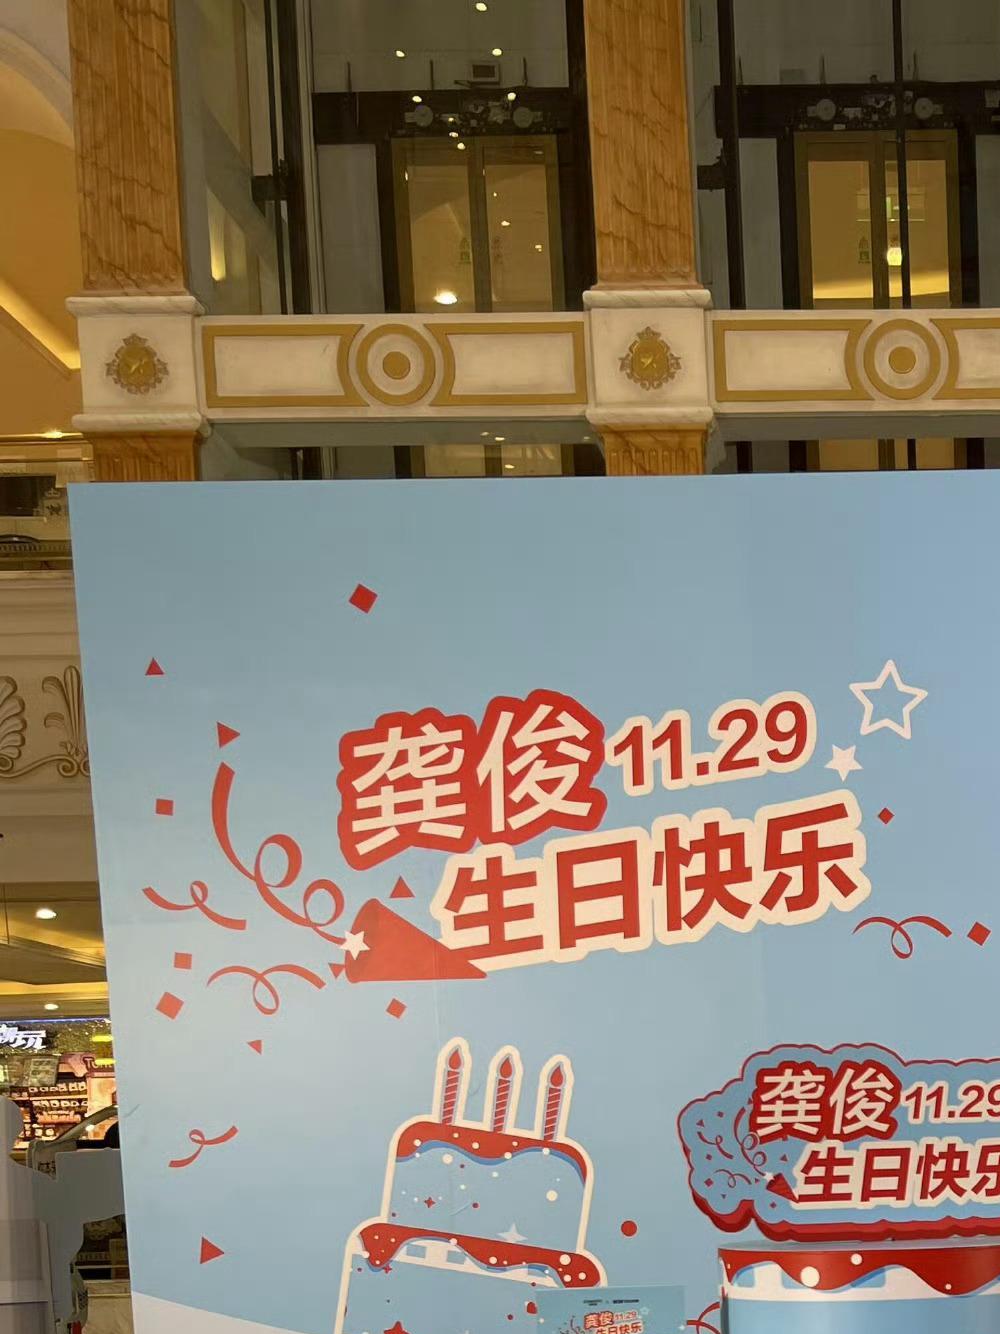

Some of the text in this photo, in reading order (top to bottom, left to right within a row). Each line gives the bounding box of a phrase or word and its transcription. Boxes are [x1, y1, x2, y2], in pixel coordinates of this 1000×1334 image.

[352, 700, 809, 856] 龚俊 11.29
[443, 801, 859, 961] 生日快乐
[756, 1066, 895, 1138] 龚俊
